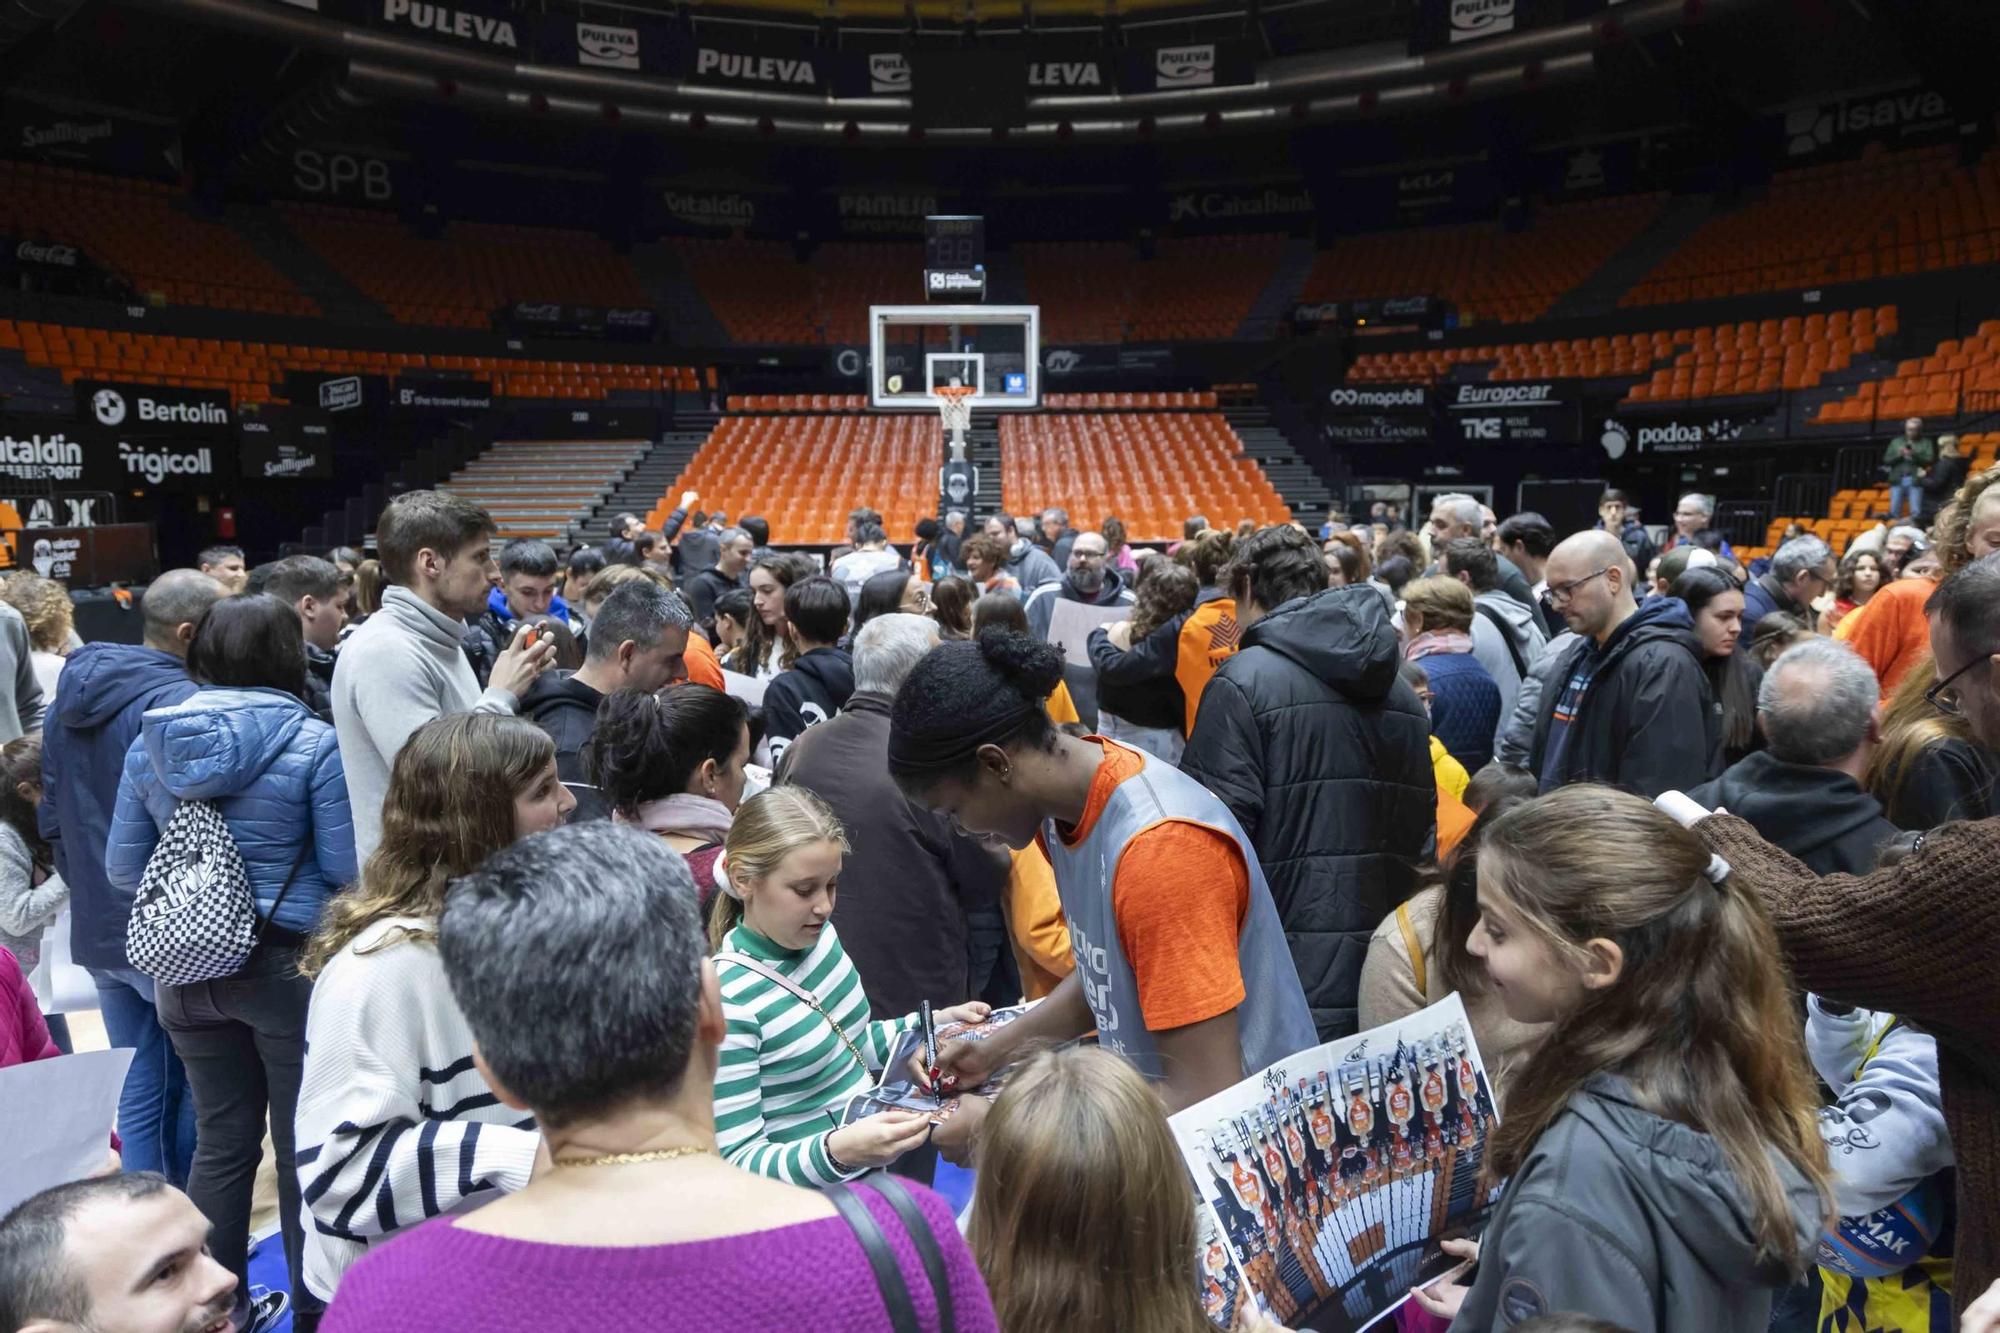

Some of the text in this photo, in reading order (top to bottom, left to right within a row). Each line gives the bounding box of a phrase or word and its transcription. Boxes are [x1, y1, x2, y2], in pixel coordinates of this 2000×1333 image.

[384, 0, 517, 48] PULEVA
[582, 29, 635, 46] PULEVA
[697, 48, 816, 85] PULEVA
[1160, 51, 1211, 66] PULEVA
[293, 150, 393, 200] SPB
[1457, 385, 1552, 406] Europcar
[138, 398, 228, 424] Bertolín
[1461, 417, 1502, 439] TKE
